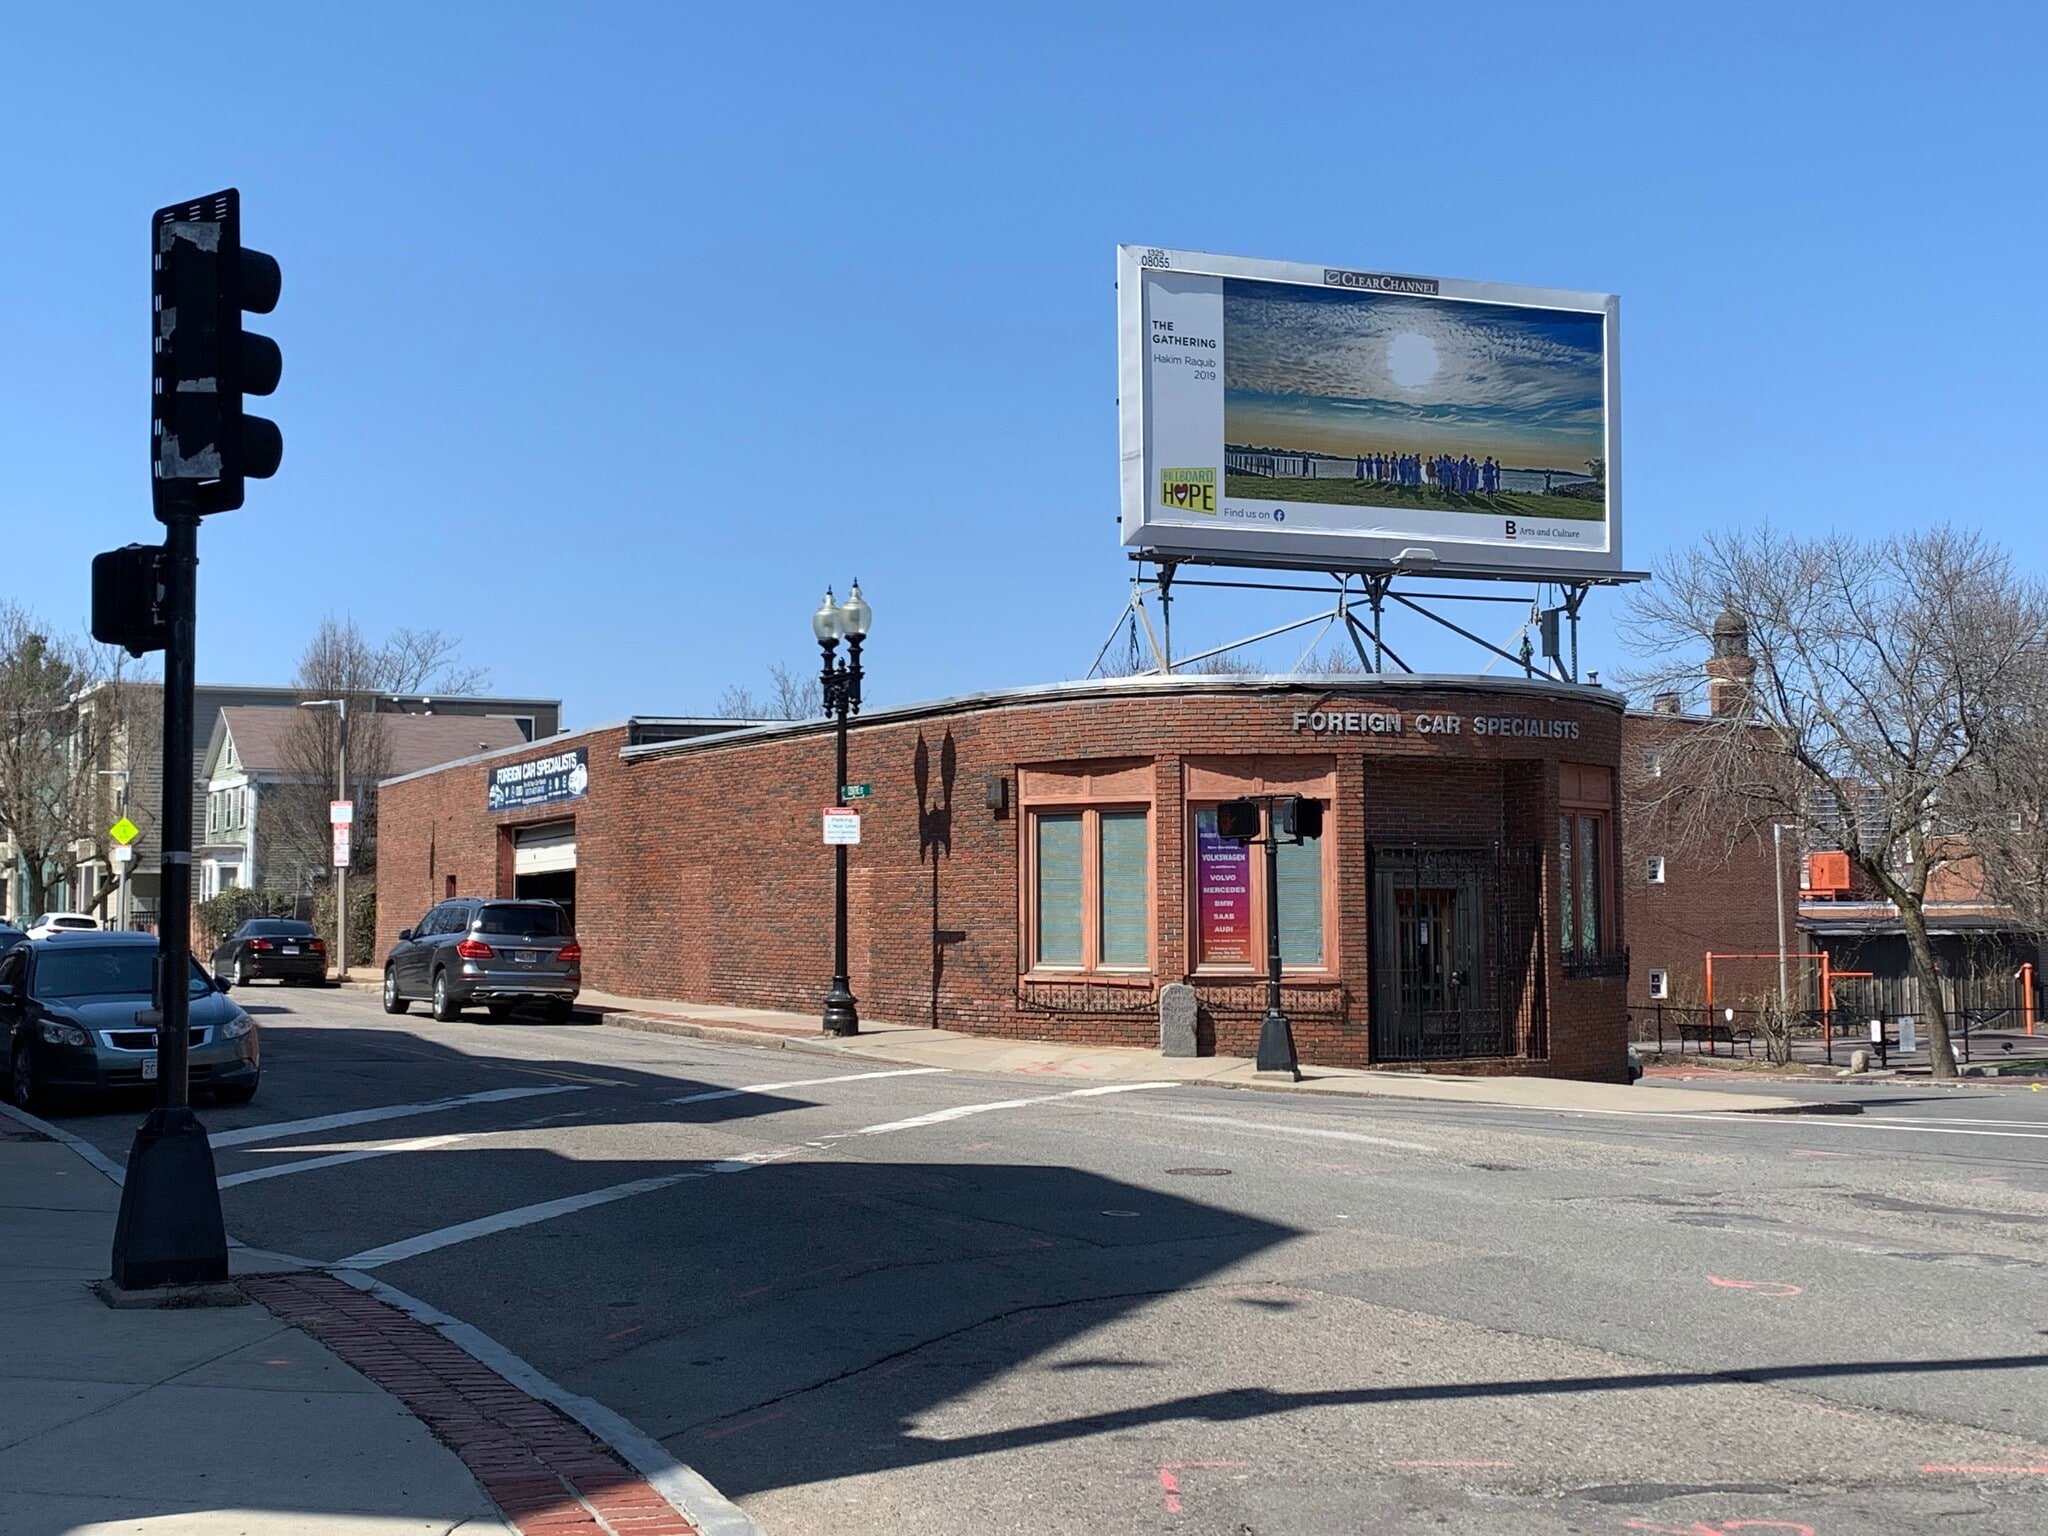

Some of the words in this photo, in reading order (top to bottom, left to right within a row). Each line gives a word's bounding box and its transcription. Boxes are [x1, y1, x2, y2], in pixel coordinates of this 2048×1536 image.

[1142, 255, 1170, 269] 08055
[1152, 320, 1174, 331] THE
[1152, 335, 1217, 349] GATHERING
[1153, 354, 1182, 364] Hakim
[1184, 356, 1216, 368] Raquib
[1194, 370, 1216, 380] 2019
[1224, 508, 1244, 518] Find
[1246, 510, 1257, 518] us
[1259, 511, 1270, 519] on
[1505, 520, 1517, 535] B
[1520, 527, 1535, 536] Arts
[1536, 528, 1551, 537] and
[1552, 529, 1580, 538] Culture
[1292, 712, 1402, 734] FOREIGN
[1415, 714, 1461, 735] CAR
[1473, 716, 1580, 740] SPECIALISTS
[496, 765, 522, 785] FOREIGN
[522, 762, 536, 780] CAR
[536, 752, 577, 777] SPECIALISTS
[1201, 853, 1246, 862] VOLKSWAGEN
